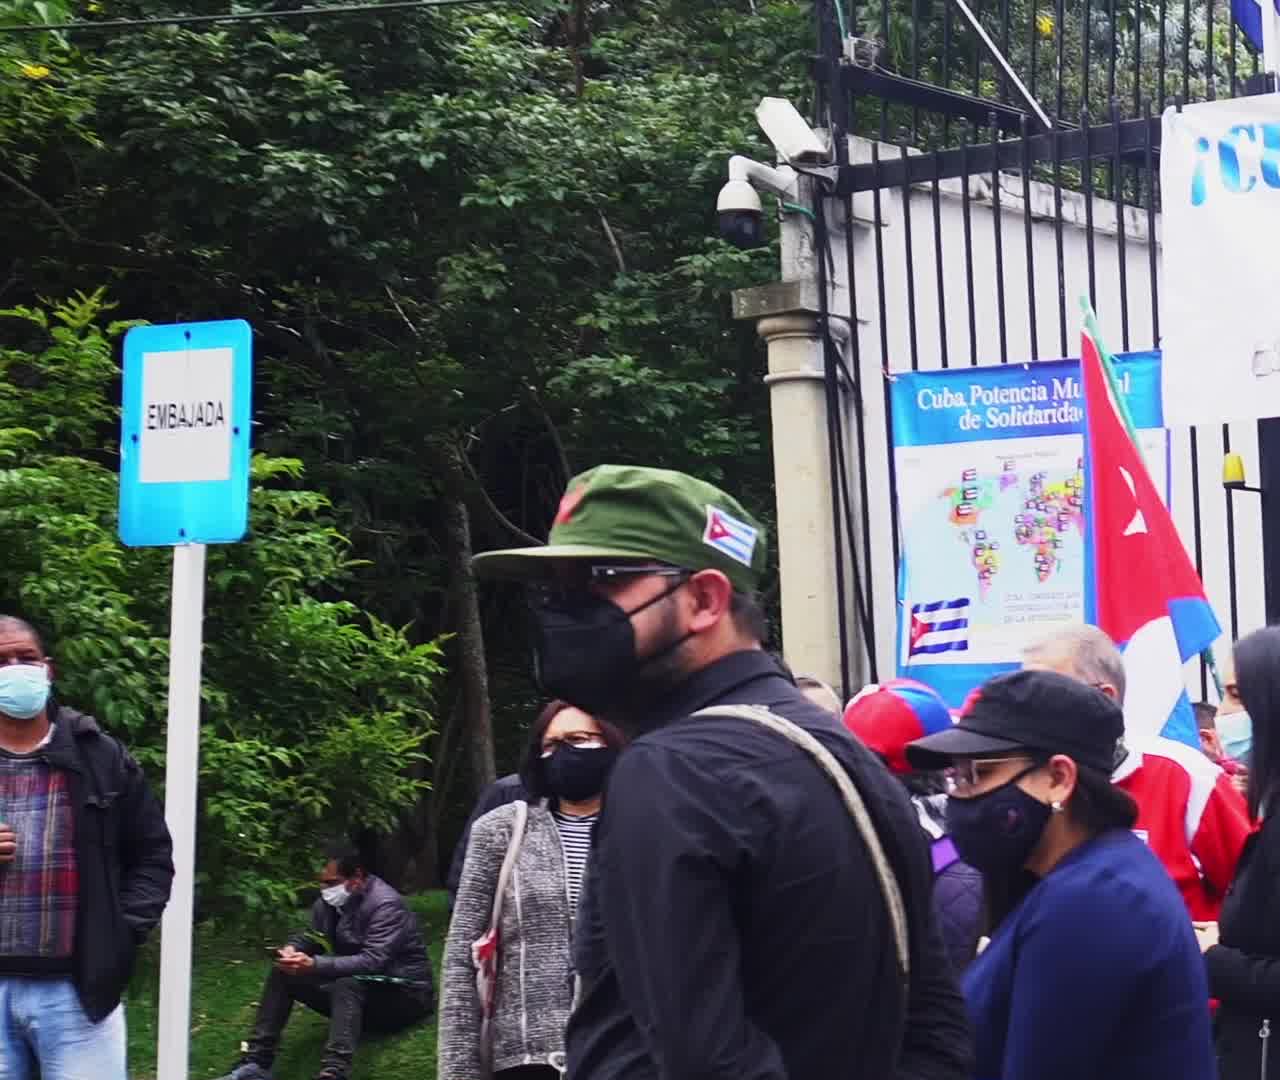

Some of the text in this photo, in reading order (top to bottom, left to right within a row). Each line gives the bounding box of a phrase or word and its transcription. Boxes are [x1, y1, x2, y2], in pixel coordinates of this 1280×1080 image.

[917, 386, 967, 411] Cuba
[969, 379, 1048, 407] Potencia
[147, 401, 224, 430] EMBAJADA
[959, 402, 1083, 431] de Solidarida
